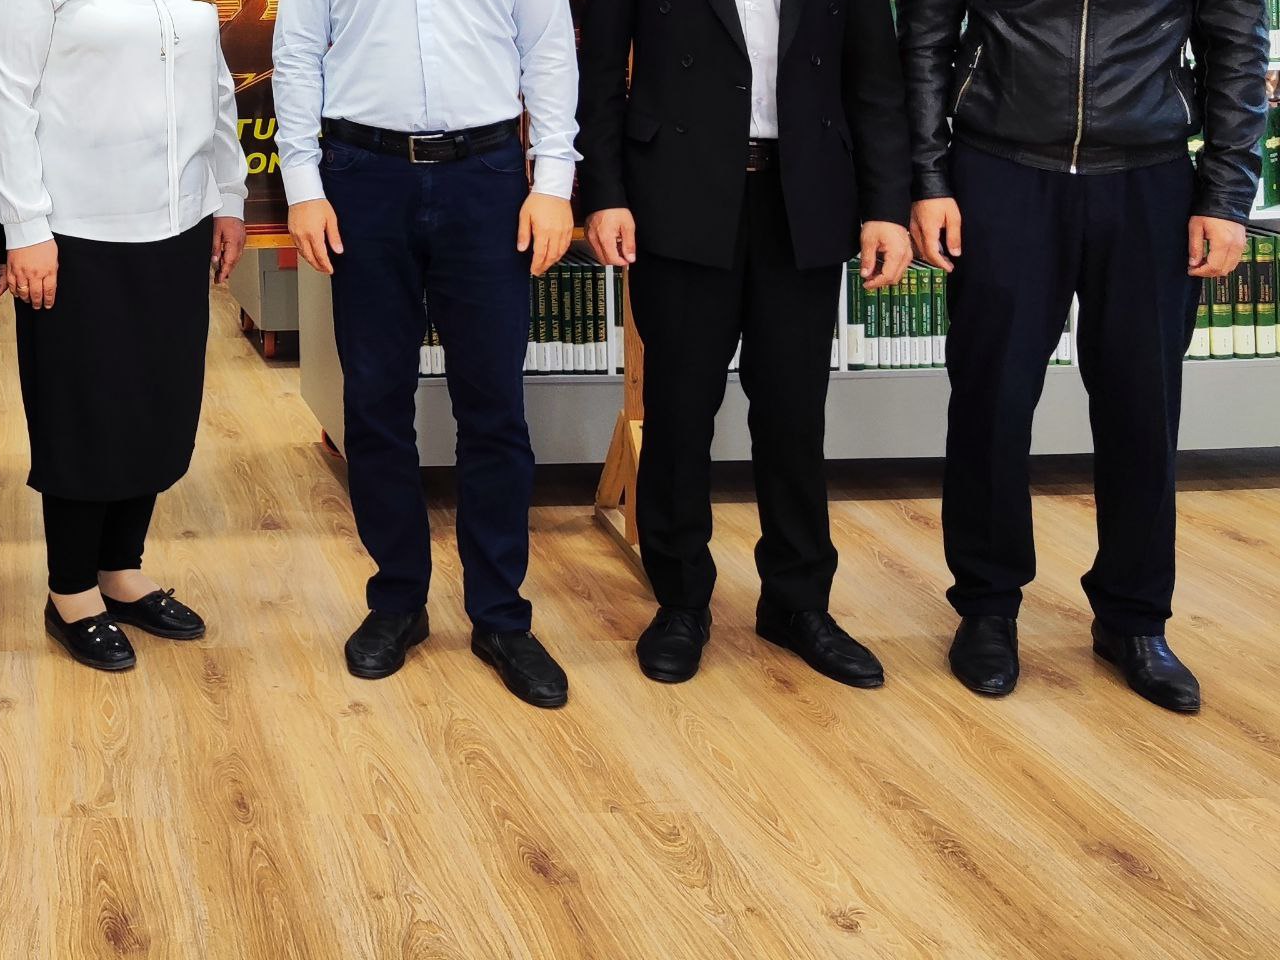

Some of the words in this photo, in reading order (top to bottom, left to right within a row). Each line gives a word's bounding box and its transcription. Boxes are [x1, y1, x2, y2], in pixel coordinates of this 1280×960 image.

[237, 118, 277, 140] TU
[248, 152, 282, 174] ON
[552, 319, 560, 342] АВКАТ
[586, 319, 594, 343] АВКАТ
[598, 319, 606, 343] АВКАТ
